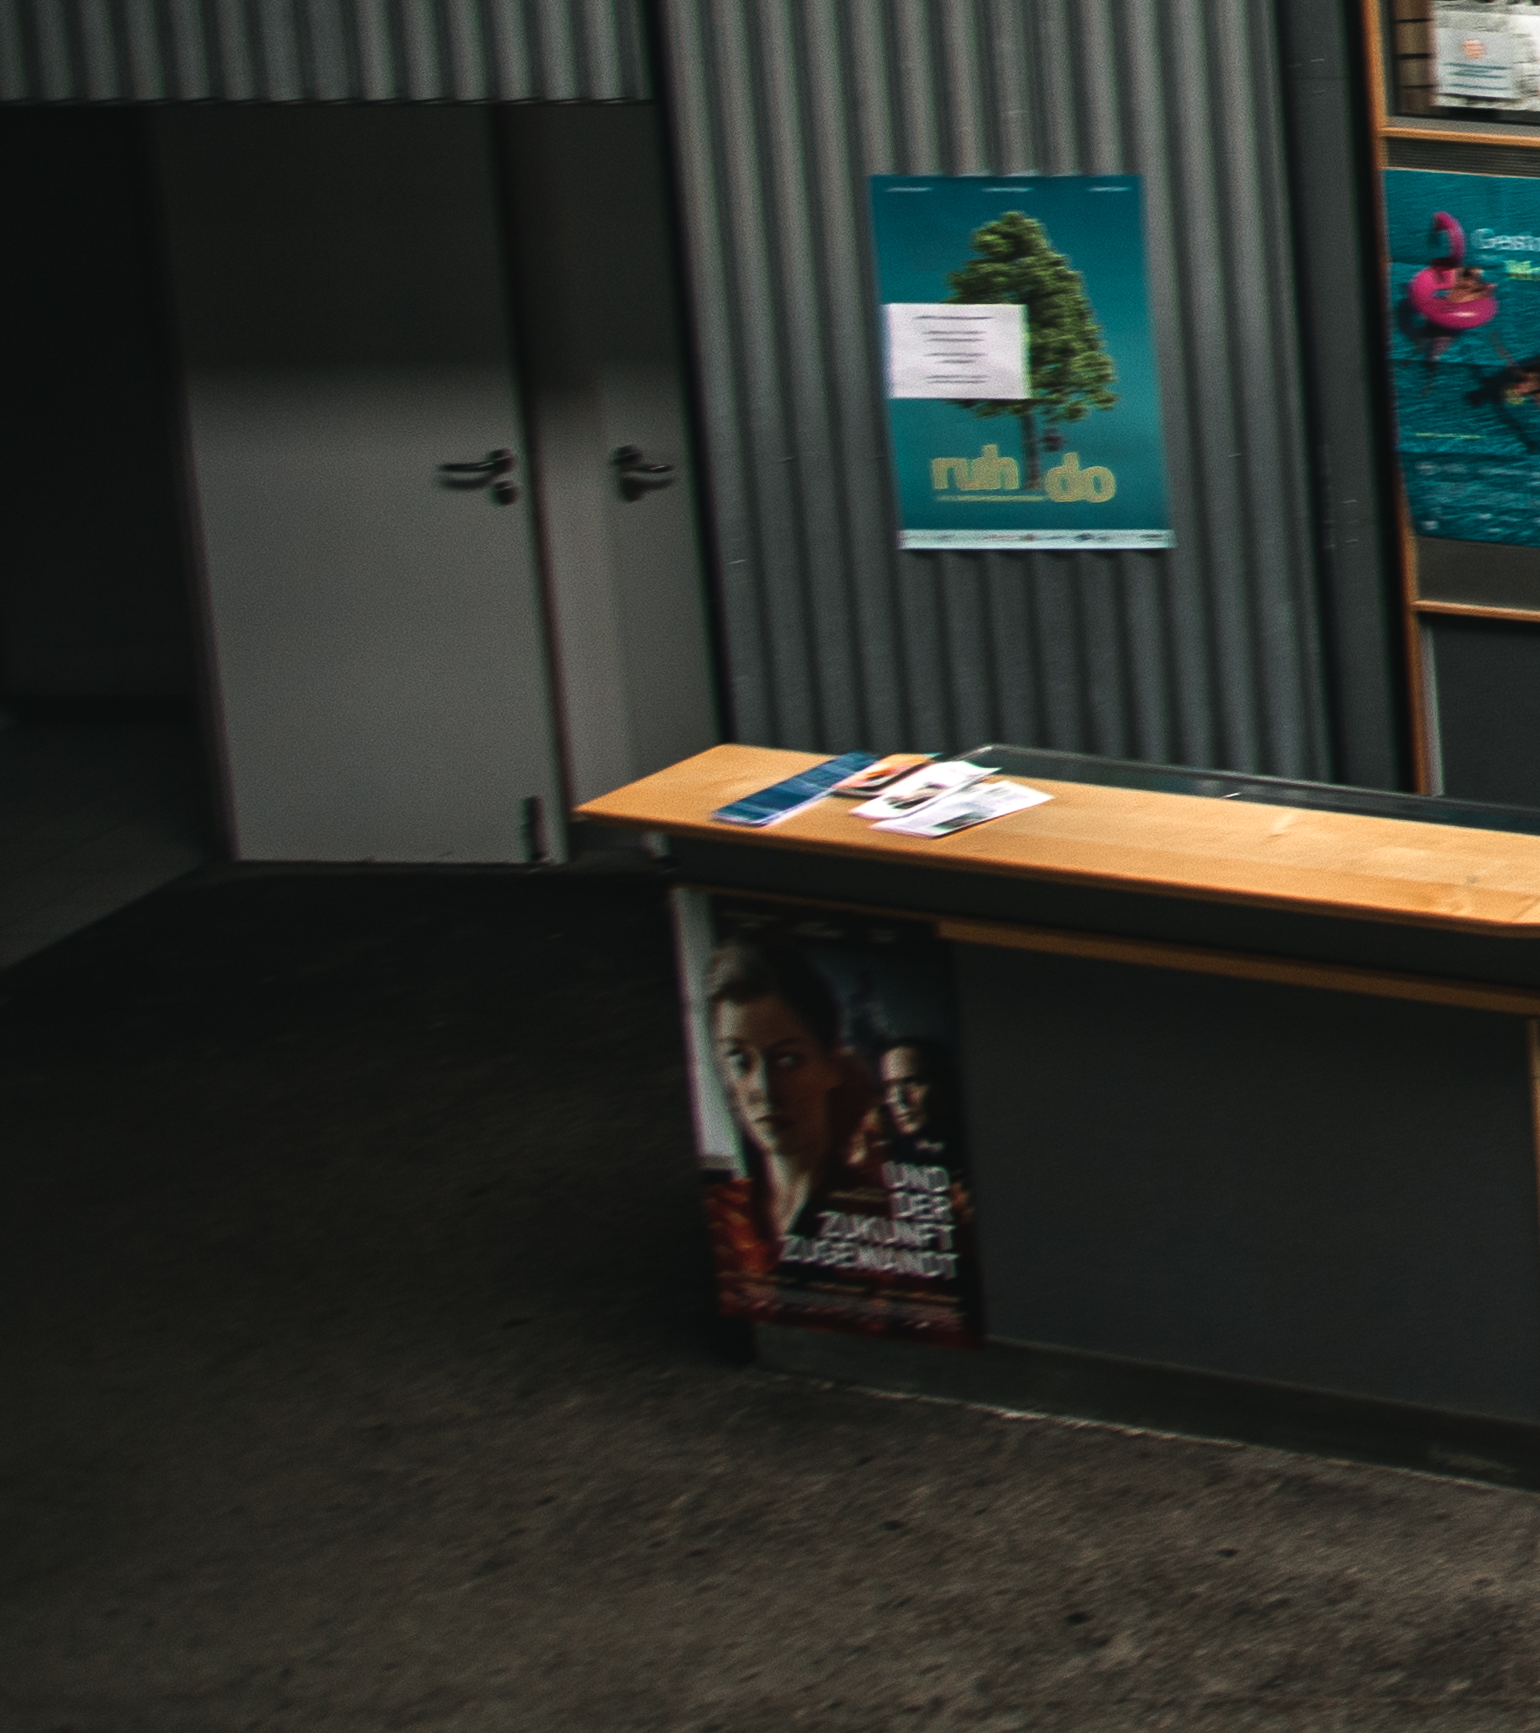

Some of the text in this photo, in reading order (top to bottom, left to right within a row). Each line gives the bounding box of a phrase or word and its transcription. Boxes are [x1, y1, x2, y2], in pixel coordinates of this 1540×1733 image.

[881, 1161, 951, 1193] UND
[889, 1191, 953, 1220] DER
[816, 1210, 956, 1250] ZUKUNFT
[778, 1234, 959, 1281] ZUGEWANDT
